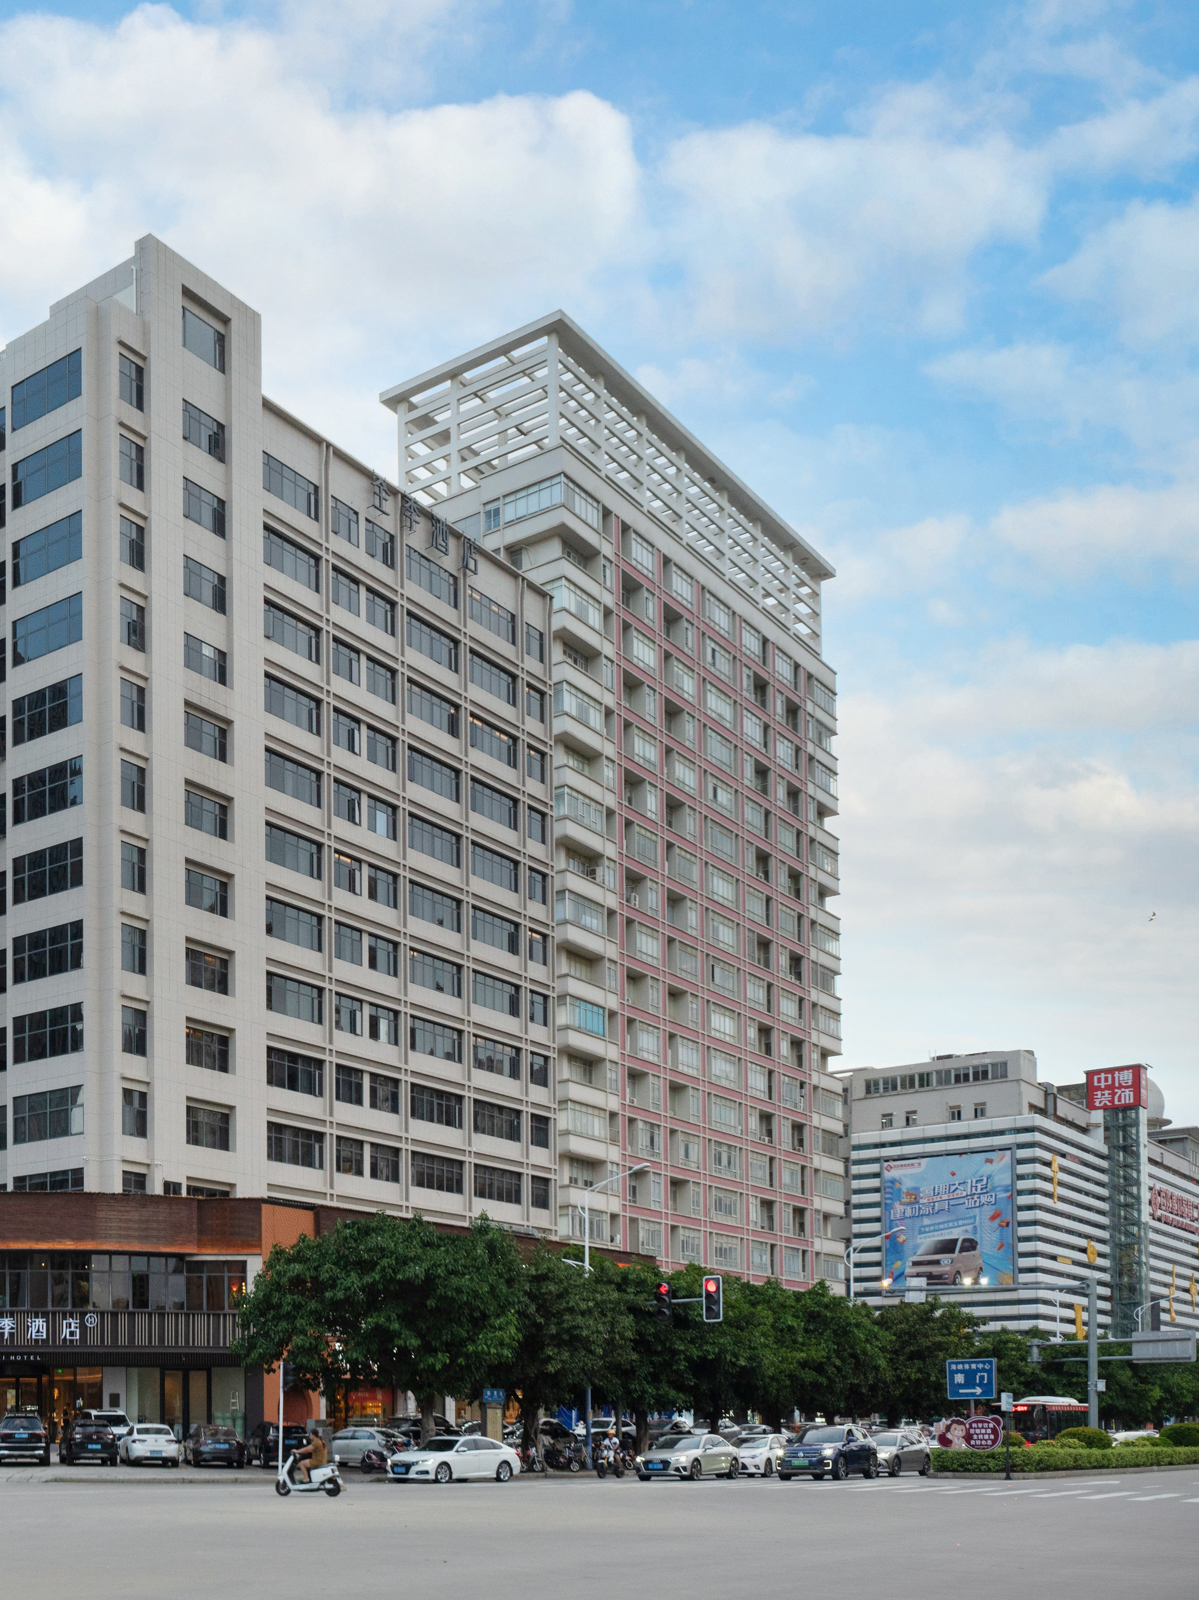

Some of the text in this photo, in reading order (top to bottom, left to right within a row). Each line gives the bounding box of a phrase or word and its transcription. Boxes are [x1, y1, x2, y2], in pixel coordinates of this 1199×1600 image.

[371, 477, 478, 576] 全季酒店
[1093, 1069, 1133, 1089] 中博
[1093, 1088, 1134, 1107] 装饰
[920, 1177, 988, 1198] 暑期大促
[954, 1372, 988, 1384] 南门
